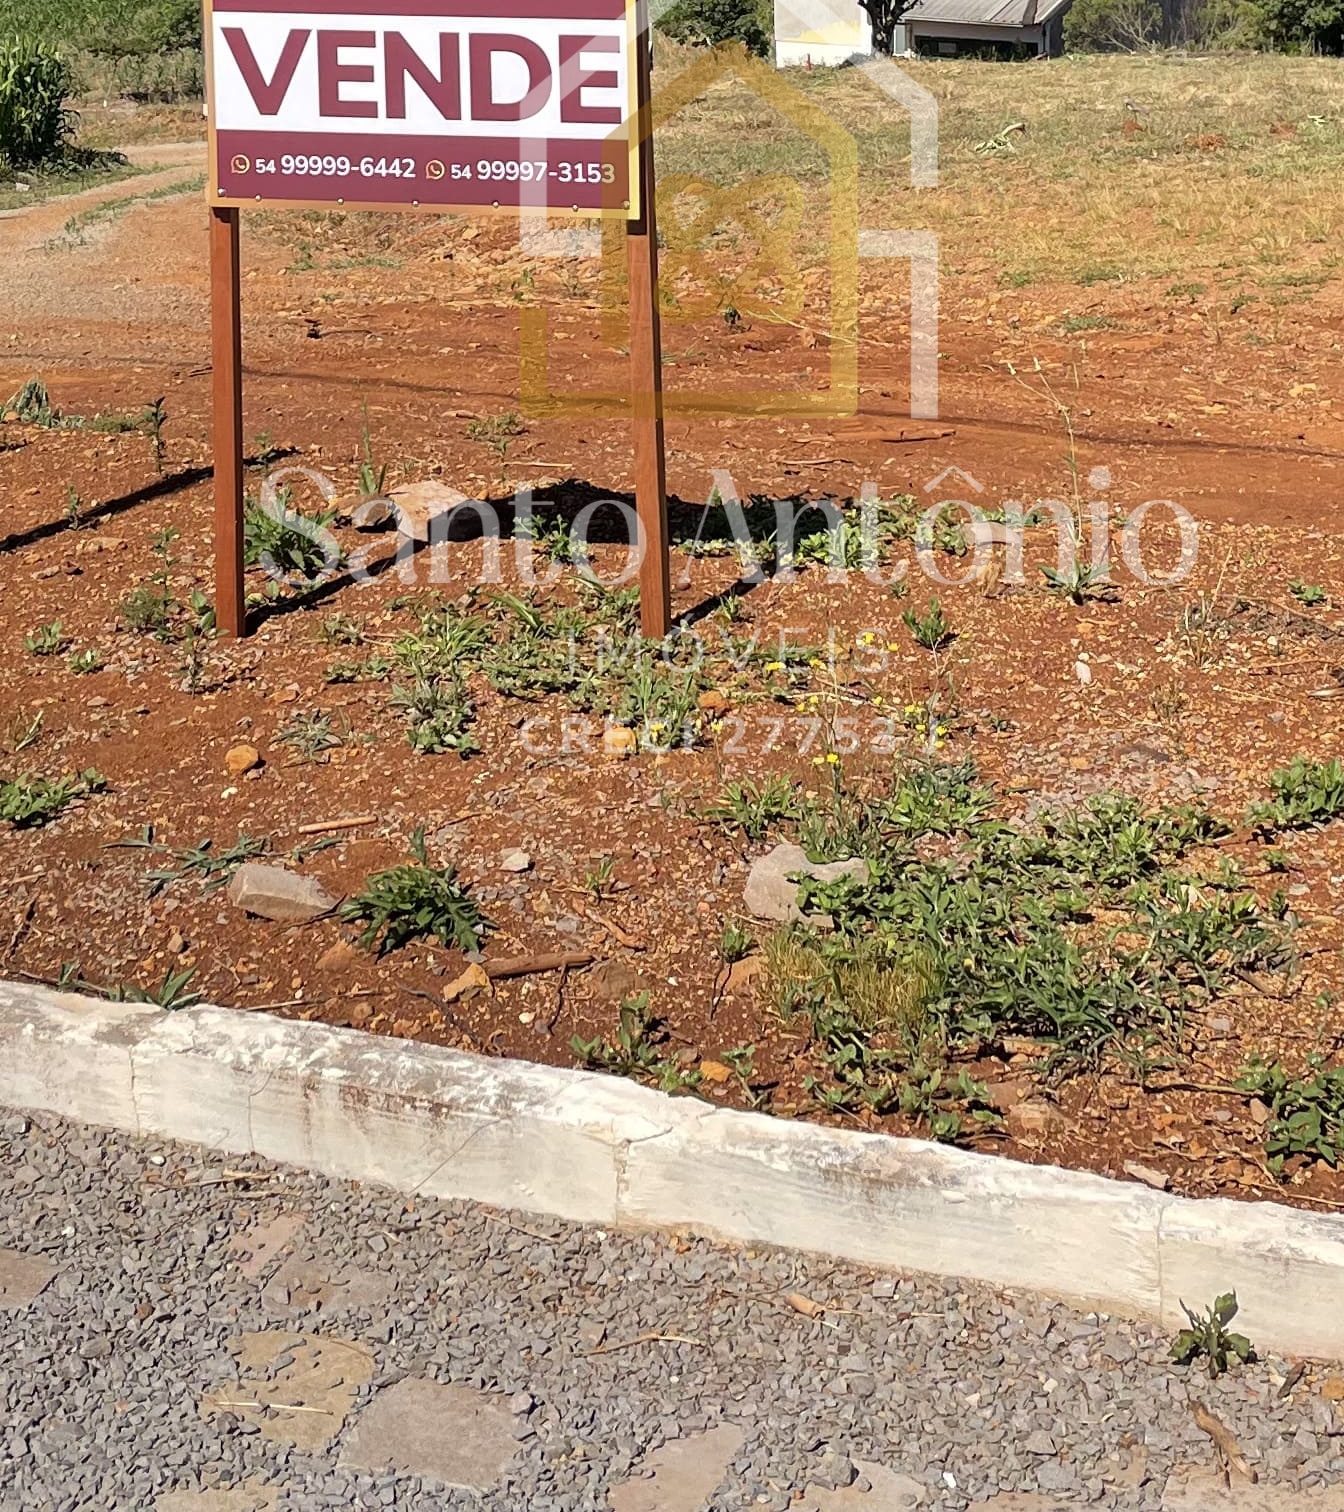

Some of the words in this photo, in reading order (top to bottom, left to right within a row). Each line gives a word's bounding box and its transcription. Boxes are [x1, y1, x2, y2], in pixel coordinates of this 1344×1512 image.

[220, 26, 623, 125] VENDE
[254, 159, 276, 174] 54
[280, 154, 416, 179] 99999-6442
[450, 164, 472, 180] 54
[476, 159, 616, 183] 99997-3153
